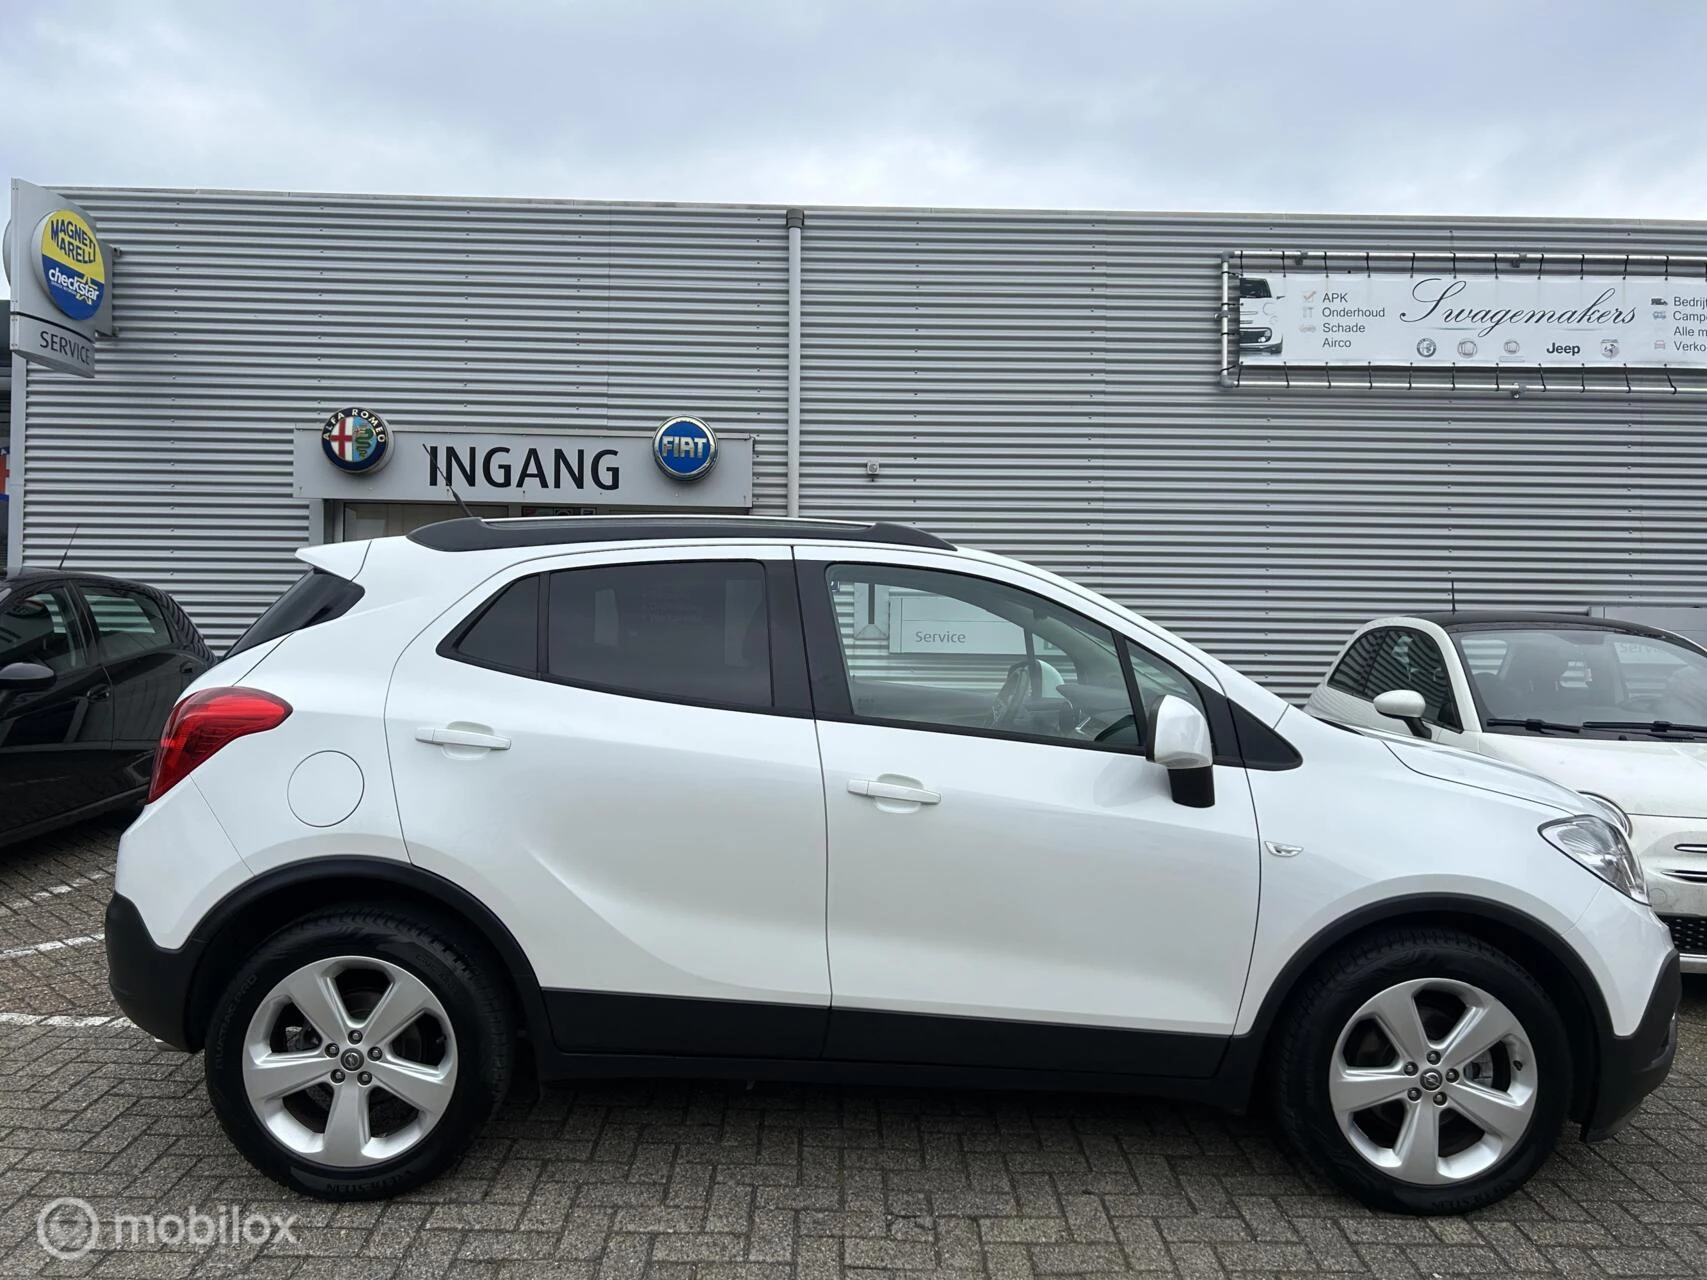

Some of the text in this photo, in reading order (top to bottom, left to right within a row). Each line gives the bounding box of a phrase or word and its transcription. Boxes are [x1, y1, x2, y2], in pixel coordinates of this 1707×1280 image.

[51, 219, 96, 250] MAGNETI
[51, 232, 96, 264] MARELLI
[49, 267, 99, 301] checkstar
[1322, 293, 1348, 303] APK
[1673, 296, 1707, 310] Bedrij
[1322, 307, 1385, 318] Onderhoud
[1400, 278, 1637, 337] Swagemakers
[1673, 310, 1707, 324] Camp
[1322, 322, 1366, 333] Schade
[1674, 326, 1695, 337] Alle
[40, 330, 90, 365] SERVICE
[1322, 338, 1352, 348] Airco
[1546, 342, 1581, 356] Jeep
[1674, 340, 1707, 352] Verko
[323, 408, 386, 443] ALFA ROMEO
[662, 435, 708, 458] FIAT
[429, 445, 620, 491] INGANG
[915, 630, 966, 644] Service
